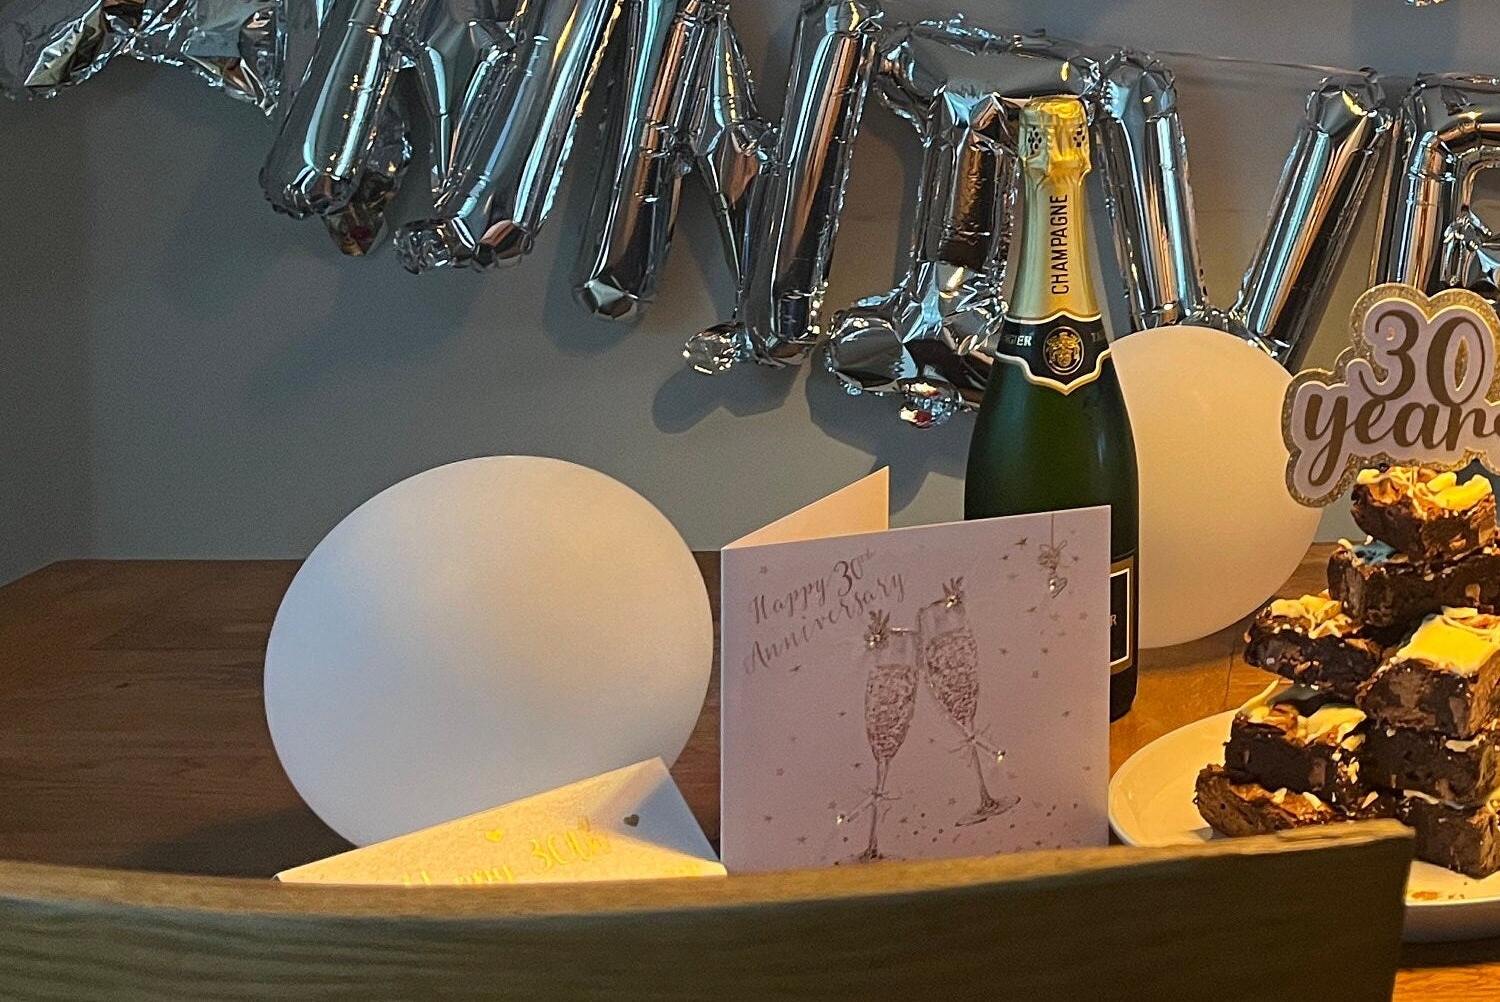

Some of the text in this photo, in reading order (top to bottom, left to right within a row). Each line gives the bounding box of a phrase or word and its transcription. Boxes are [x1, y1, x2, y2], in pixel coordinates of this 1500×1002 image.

[1050, 193, 1069, 295] CHAMPAGNE
[1358, 309, 1486, 408] 30
[744, 573, 905, 675] Anniversary
[753, 577, 826, 625] Happy
